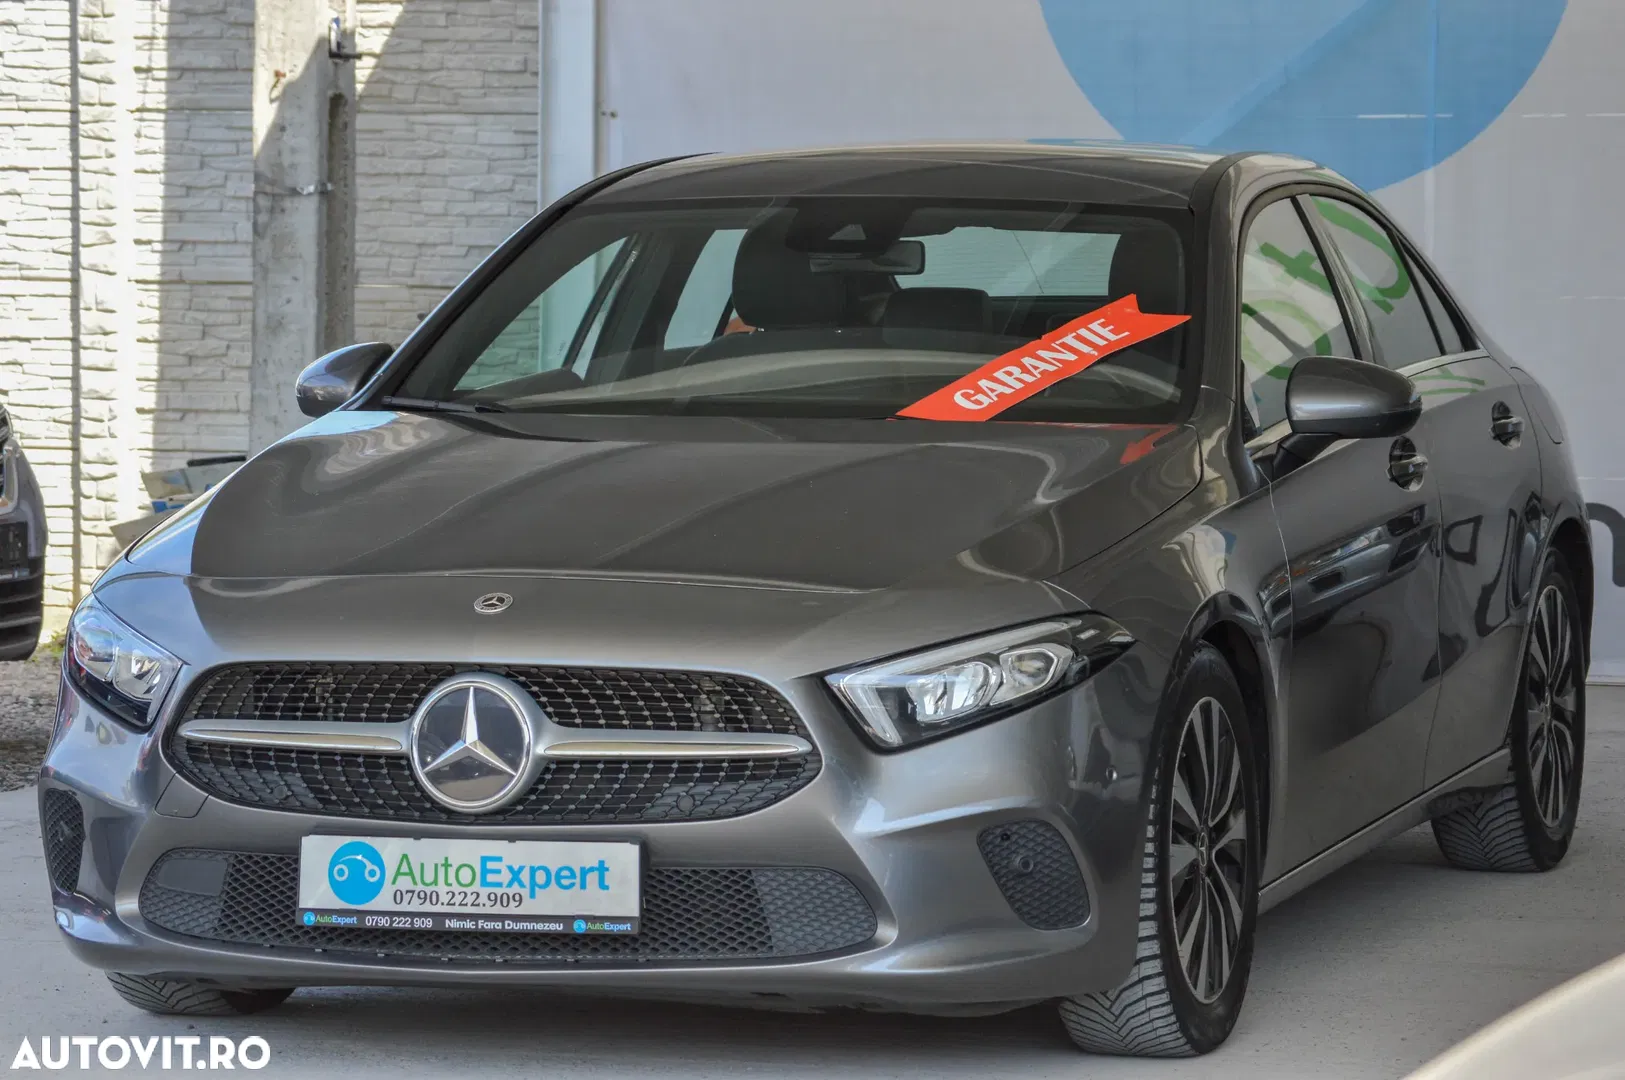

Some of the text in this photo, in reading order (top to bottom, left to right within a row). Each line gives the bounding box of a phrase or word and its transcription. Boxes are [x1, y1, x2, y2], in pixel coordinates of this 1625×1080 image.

[391, 853, 610, 899] AutoExpert
[393, 889, 523, 908] 0790.222.909
[315, 915, 632, 932] AutoExpert 0790 222 909 Nimic Fara Dumnezeu AutoExpert
